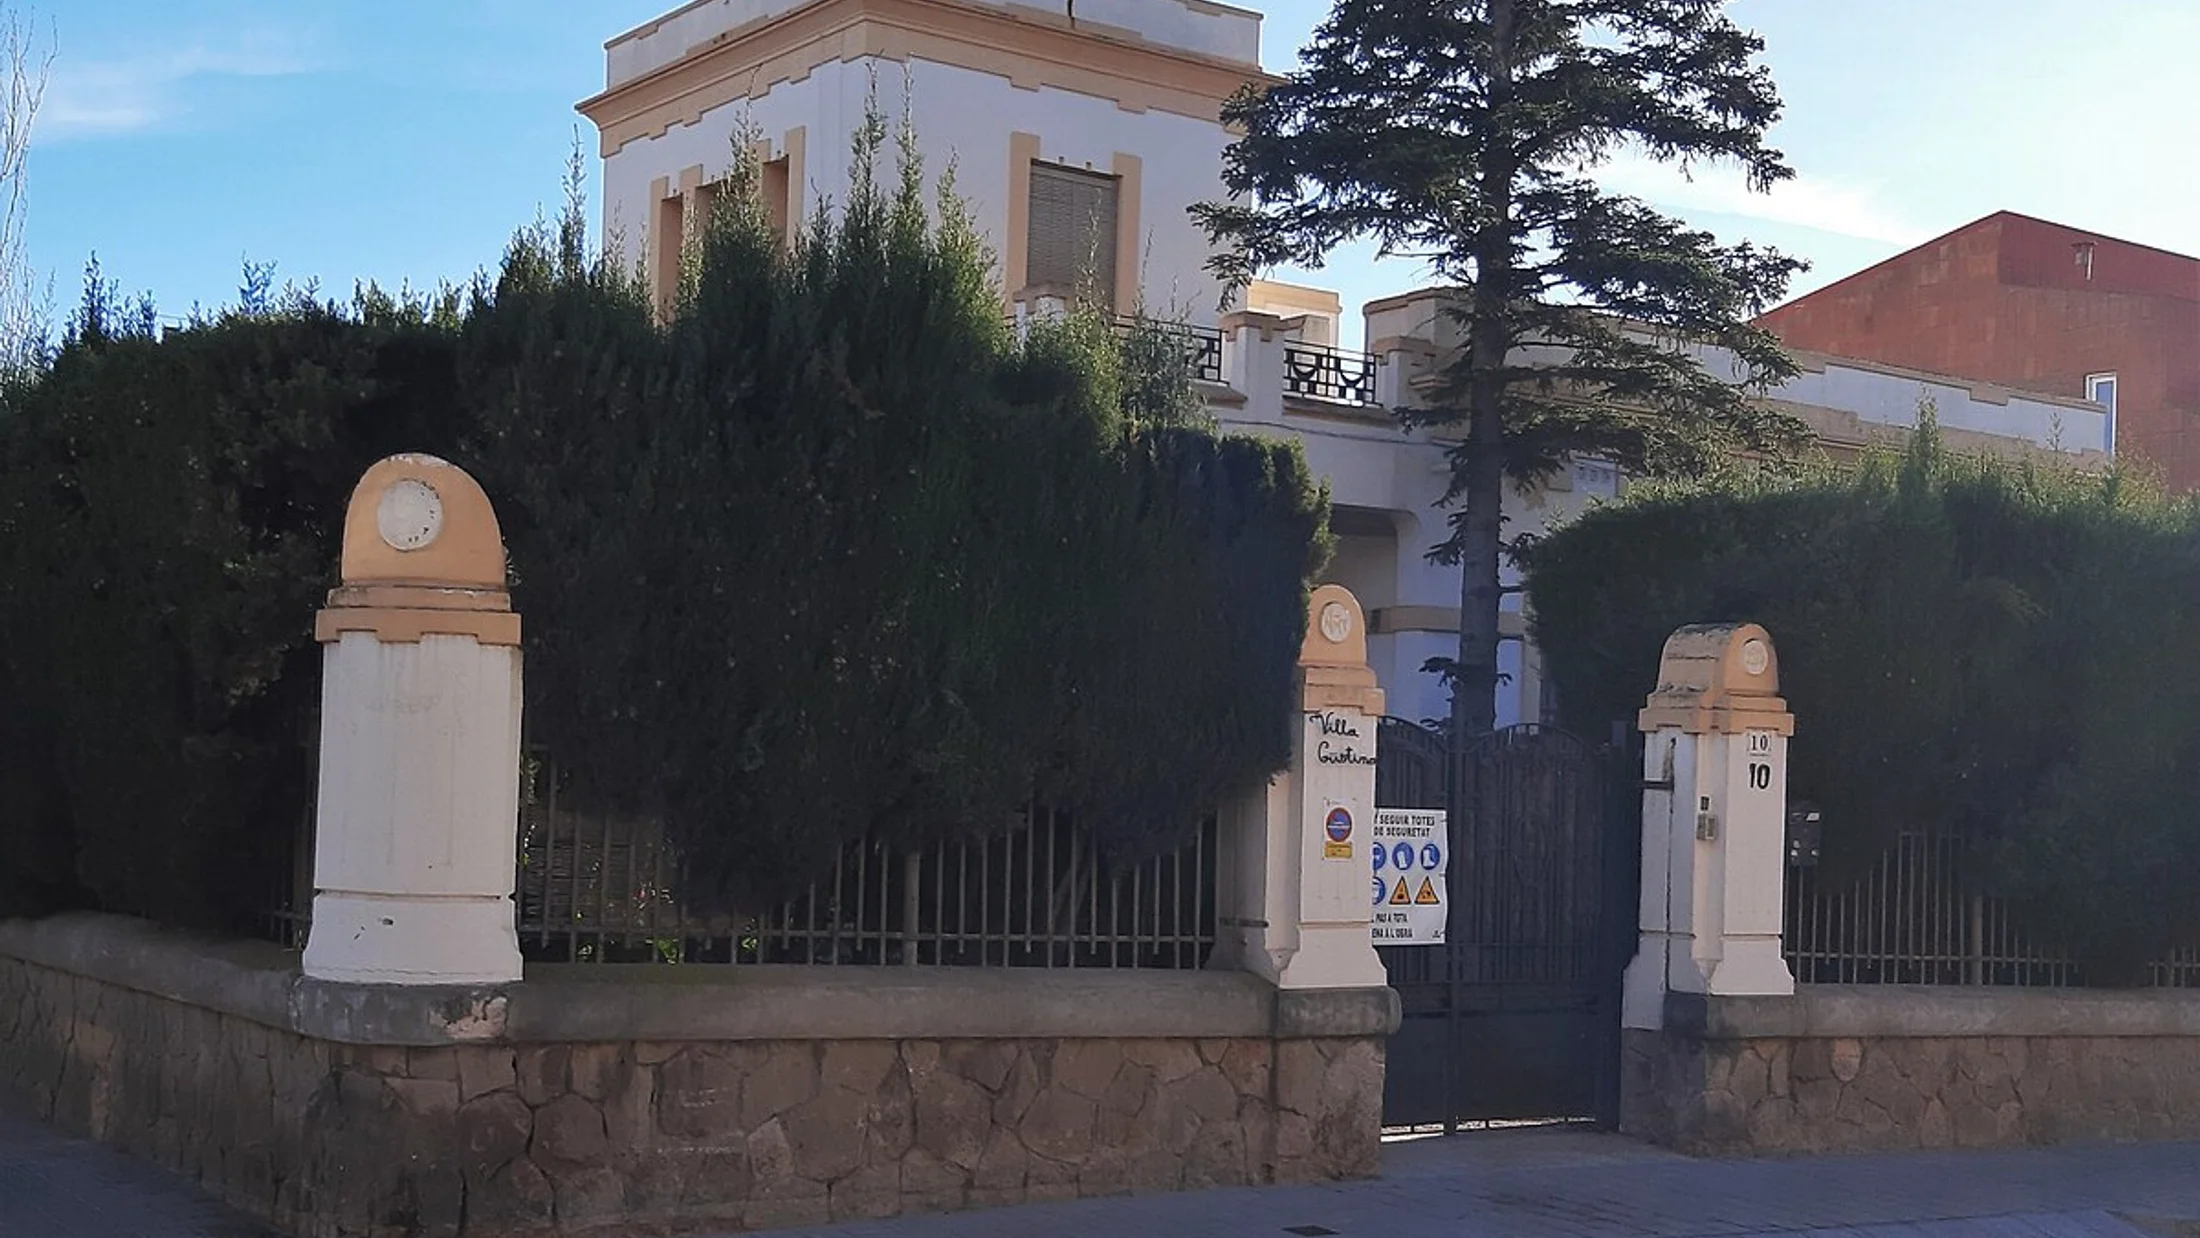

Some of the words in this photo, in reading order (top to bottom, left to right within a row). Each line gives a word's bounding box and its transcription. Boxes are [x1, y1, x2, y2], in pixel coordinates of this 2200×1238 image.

[1309, 712, 1359, 738] Villa
[1752, 735, 1768, 751] 10
[1749, 763, 1770, 789] 10
[1380, 814, 1409, 825] SEGUIR
[1412, 816, 1435, 826] TOTES
[1386, 827, 1431, 837] SEGURETAT
